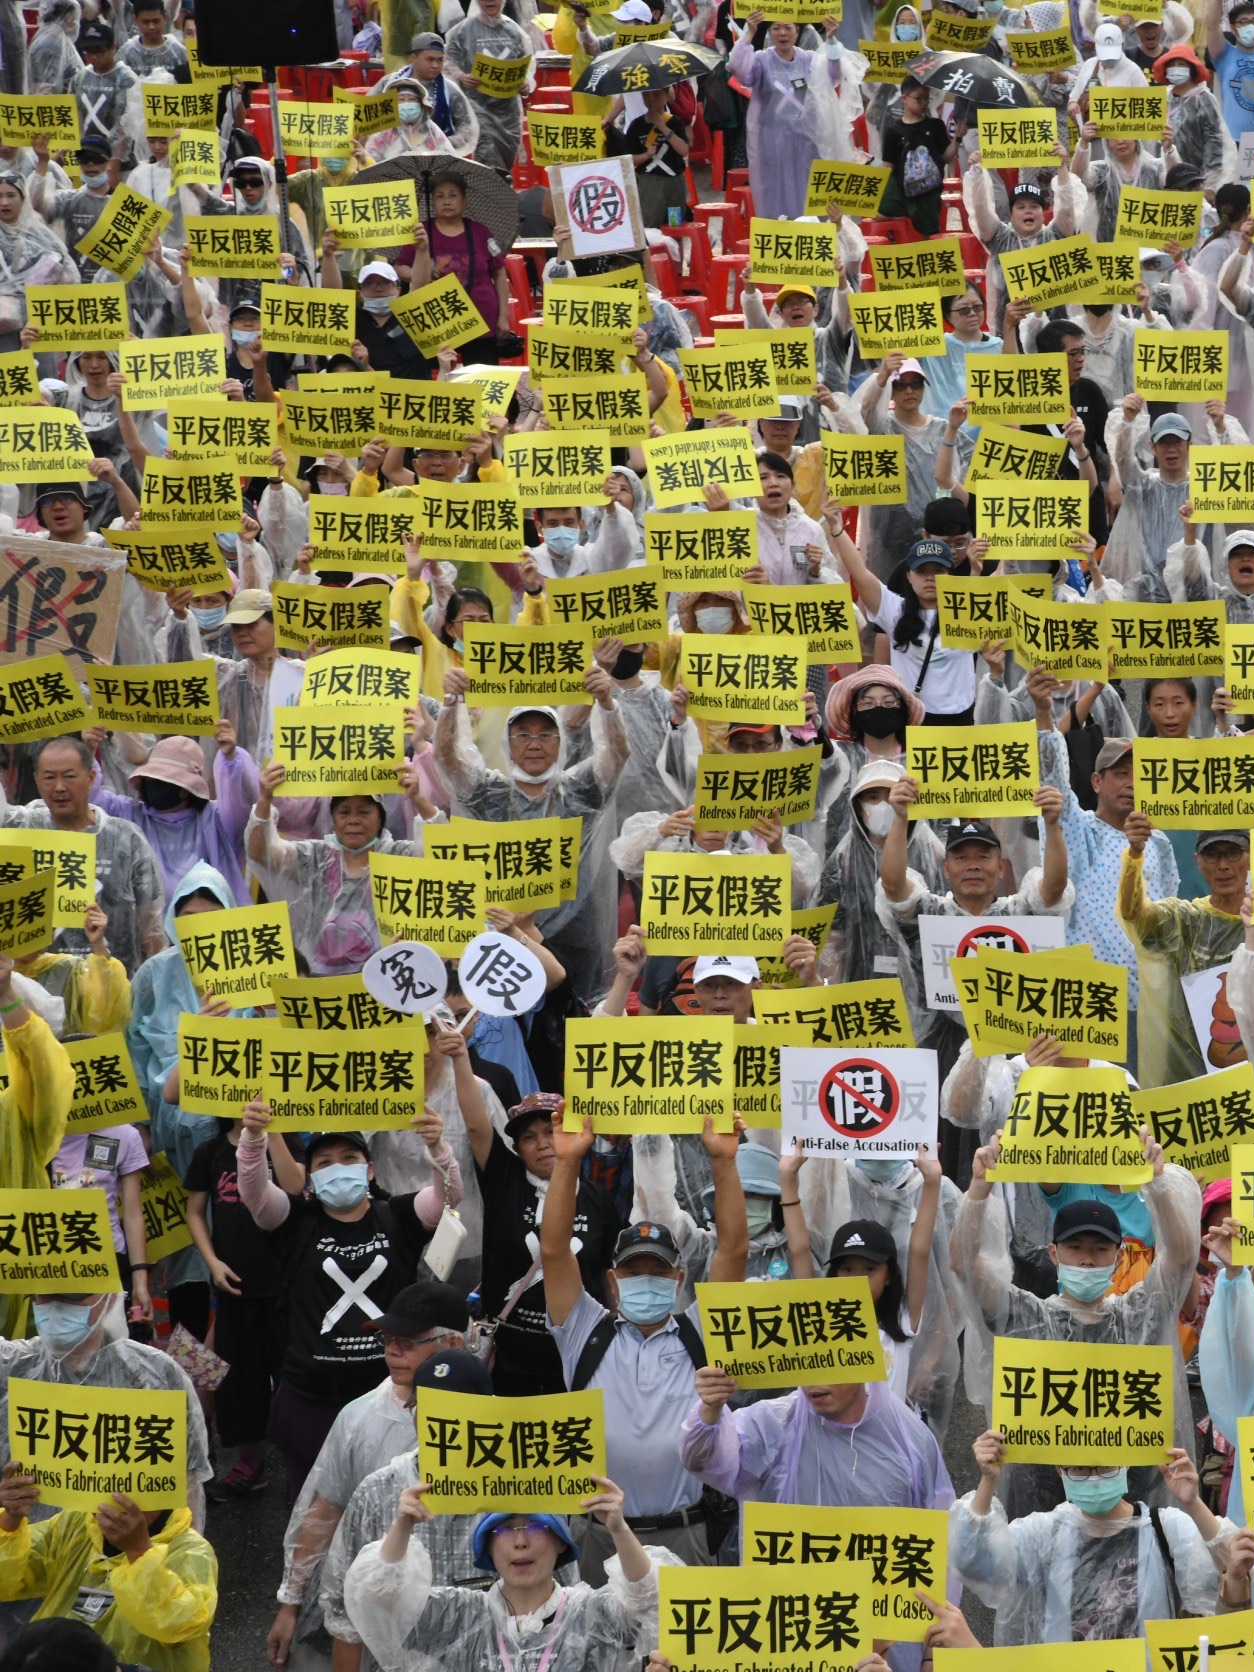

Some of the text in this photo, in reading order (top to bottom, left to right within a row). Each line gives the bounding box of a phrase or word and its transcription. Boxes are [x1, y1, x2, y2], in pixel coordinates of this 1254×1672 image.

[1014, 184, 1041, 196] GET OUT
[188, 228, 274, 255] 平反假案
[191, 256, 276, 269] Redress Fabricated Cases
[263, 298, 349, 331] 平反假案
[262, 328, 349, 347] Redress Fabricated Cases
[125, 348, 218, 383] 平反假案
[1137, 344, 1222, 374] 平反假案
[127, 388, 157, 399] Redress
[159, 383, 197, 397] Fabricated
[970, 366, 1063, 398] 平反假案
[1136, 376, 1222, 391] Redress Fabricated Cases
[971, 400, 1065, 414] Redress Fabricated Cases
[650, 438, 747, 457] Redress Fabricated Cases
[655, 454, 754, 491] 平反假案
[916, 543, 943, 557] GAP
[1110, 616, 1220, 650] 平反假案
[1112, 652, 1224, 667] Redress Fabricated Cases
[687, 653, 799, 691] 平反假案
[93, 676, 210, 709] 平反假案
[689, 691, 798, 711] Redress Fabricated Cases
[97, 706, 213, 725] Redress Fabricated Cases
[648, 874, 782, 918] 平反假案
[646, 921, 782, 941] Redress Fabricated Cases
[465, 942, 532, 1011] 假
[268, 1049, 414, 1092] 平反假案
[269, 1097, 415, 1116] Redress Fabricated Cases
[1000, 1366, 1162, 1420] 平反假案
[1055, 1424, 1122, 1446] Fabricated
[1126, 1426, 1164, 1447] Cases
